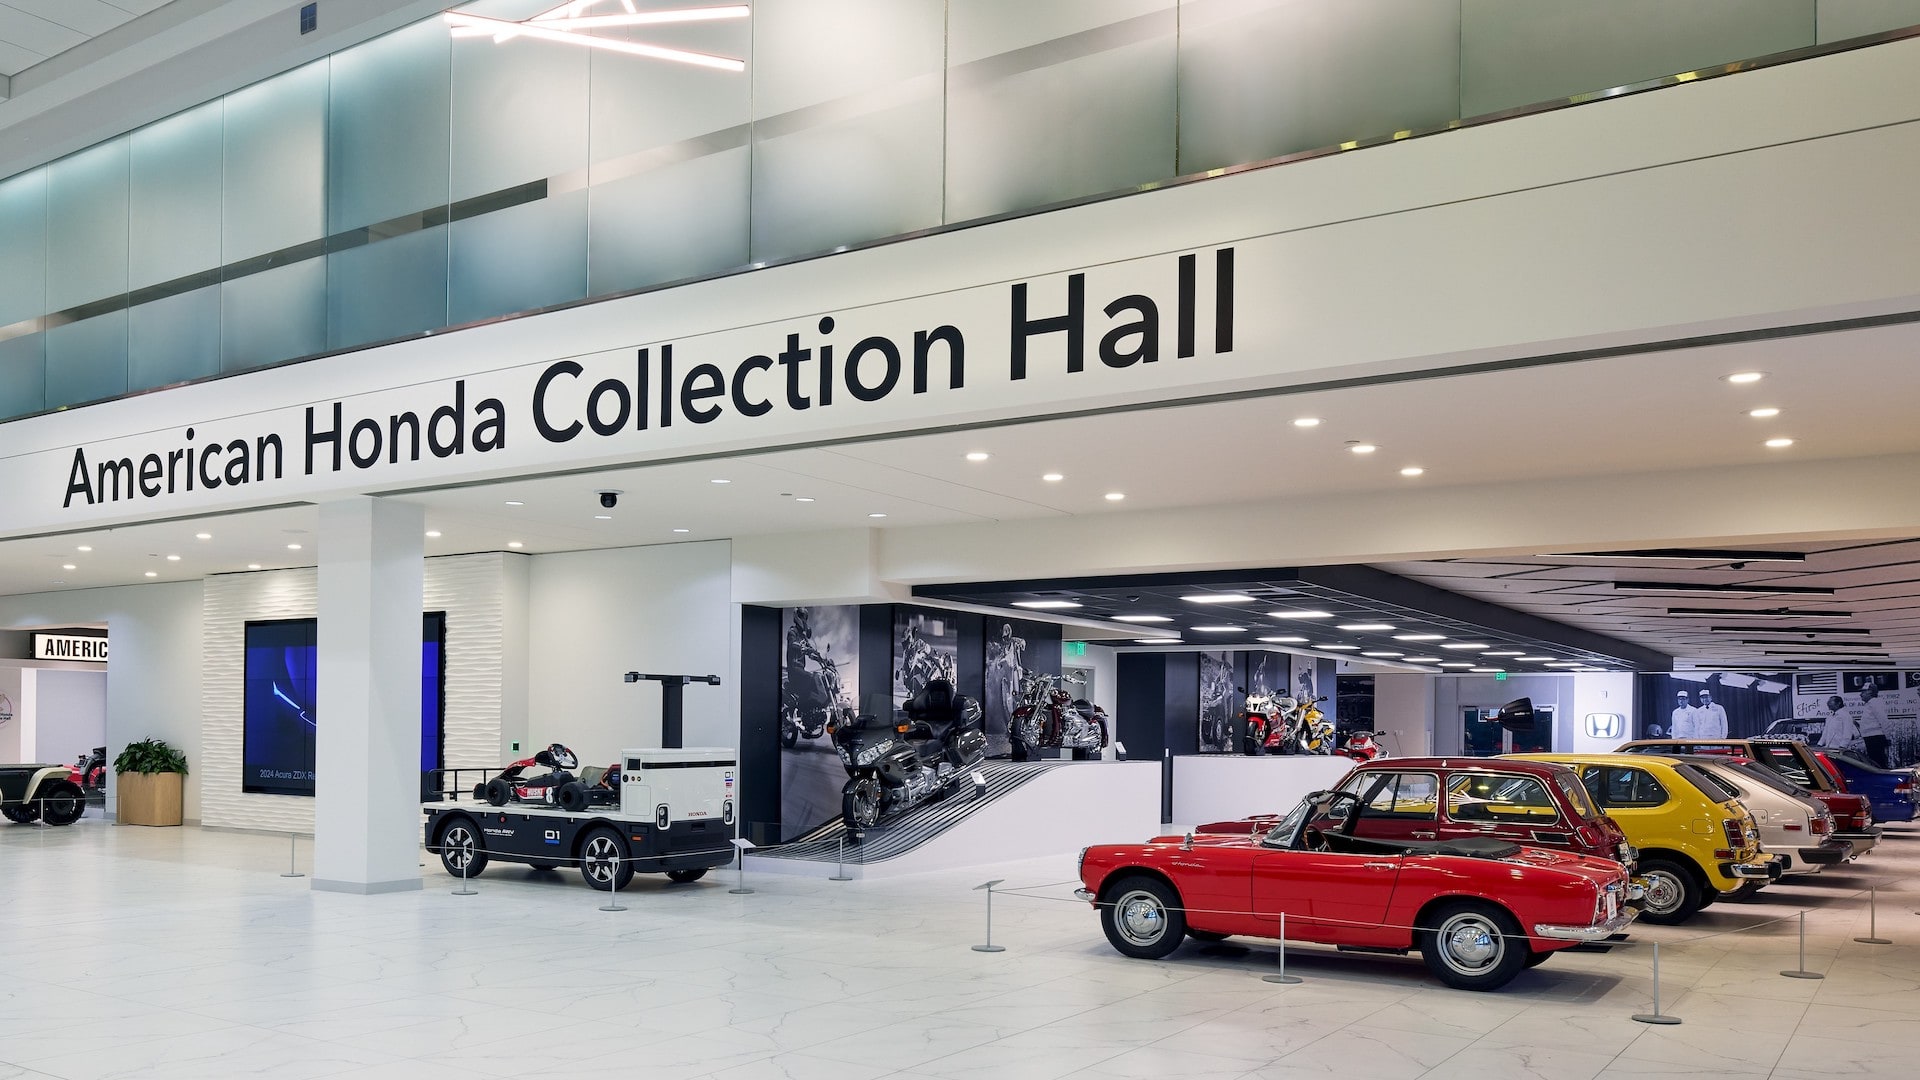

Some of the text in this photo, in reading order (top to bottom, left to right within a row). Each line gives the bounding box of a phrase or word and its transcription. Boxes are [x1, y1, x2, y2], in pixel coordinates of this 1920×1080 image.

[64, 247, 1235, 508] American Honda Collection Hall
[259, 768, 275, 778] 2024
[275, 770, 292, 779] Acura
[293, 771, 307, 780] ZDX
[545, 786, 554, 804] 8
[544, 830, 560, 840] 01
